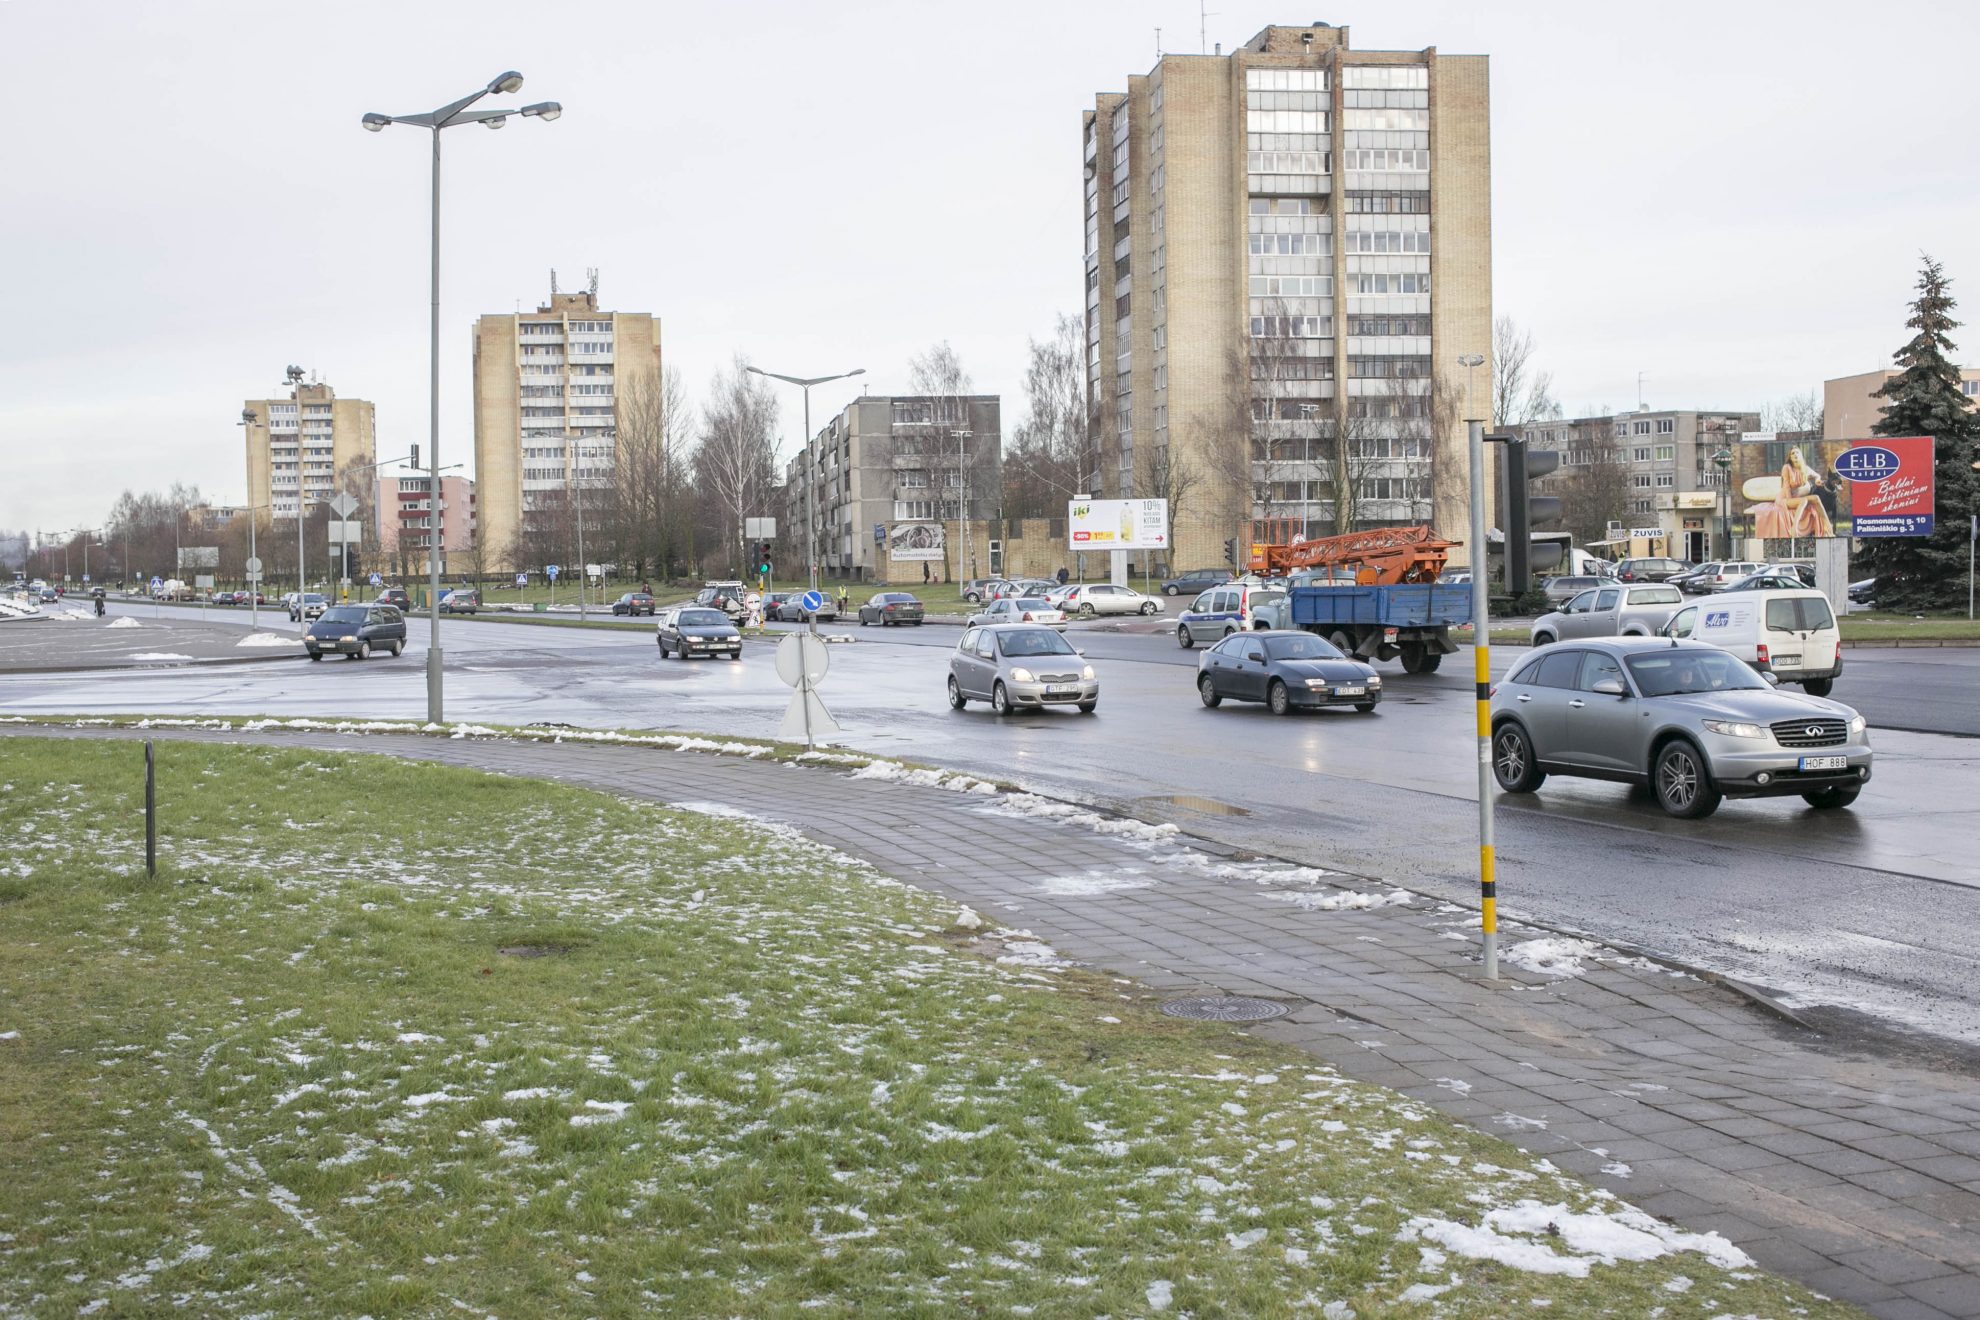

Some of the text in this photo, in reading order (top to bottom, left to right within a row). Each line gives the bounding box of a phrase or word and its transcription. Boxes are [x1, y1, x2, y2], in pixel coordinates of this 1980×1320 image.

[1878, 476, 1915, 493] Baldai
[1867, 485, 1928, 507] išskirtiniam
[1143, 500, 1161, 511] 10%
[1882, 495, 1920, 513] skoniui
[1074, 504, 1090, 516] iki
[1143, 517, 1161, 525] KITAM
[1857, 518, 1905, 526] Kosmonautų
[1805, 757, 1845, 768] HOF 888
